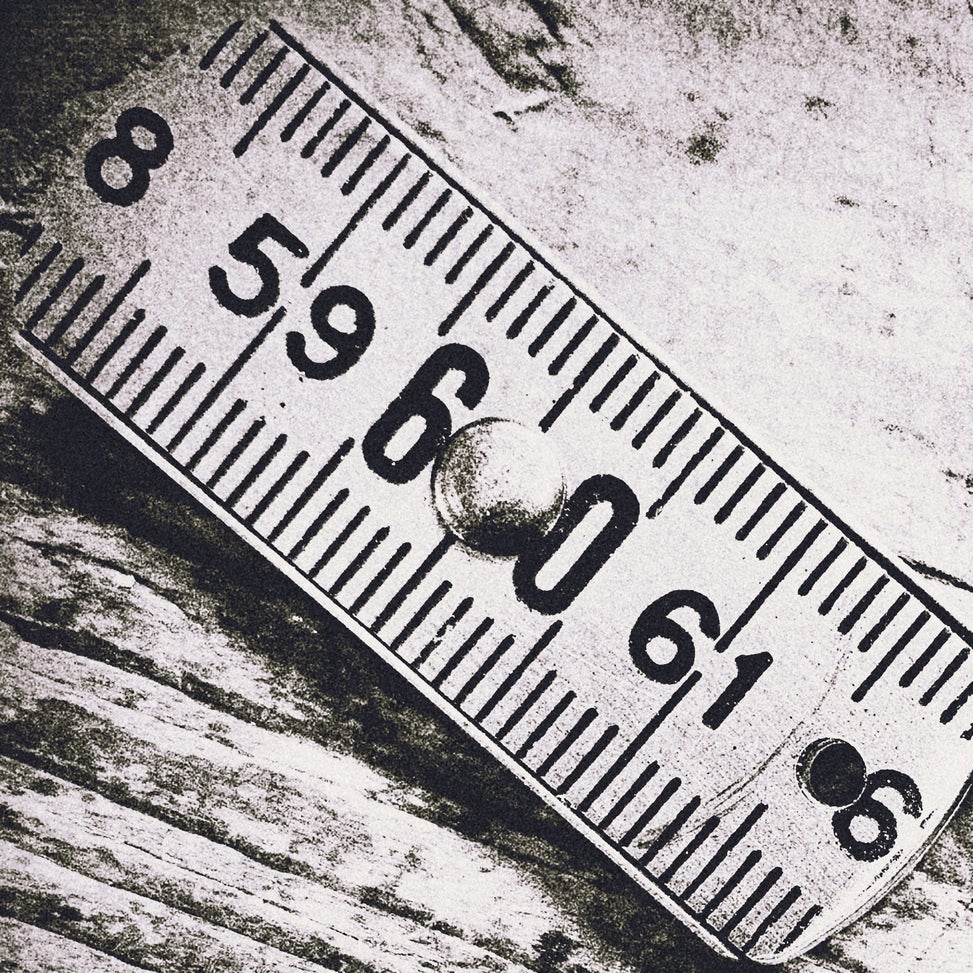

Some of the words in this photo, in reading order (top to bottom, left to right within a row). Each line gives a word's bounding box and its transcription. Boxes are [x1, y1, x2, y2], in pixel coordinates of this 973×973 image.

[83, 106, 175, 207] 8
[209, 213, 376, 380] 59
[362, 343, 641, 616] 60
[628, 589, 774, 729] 61
[833, 769, 923, 862] 6
